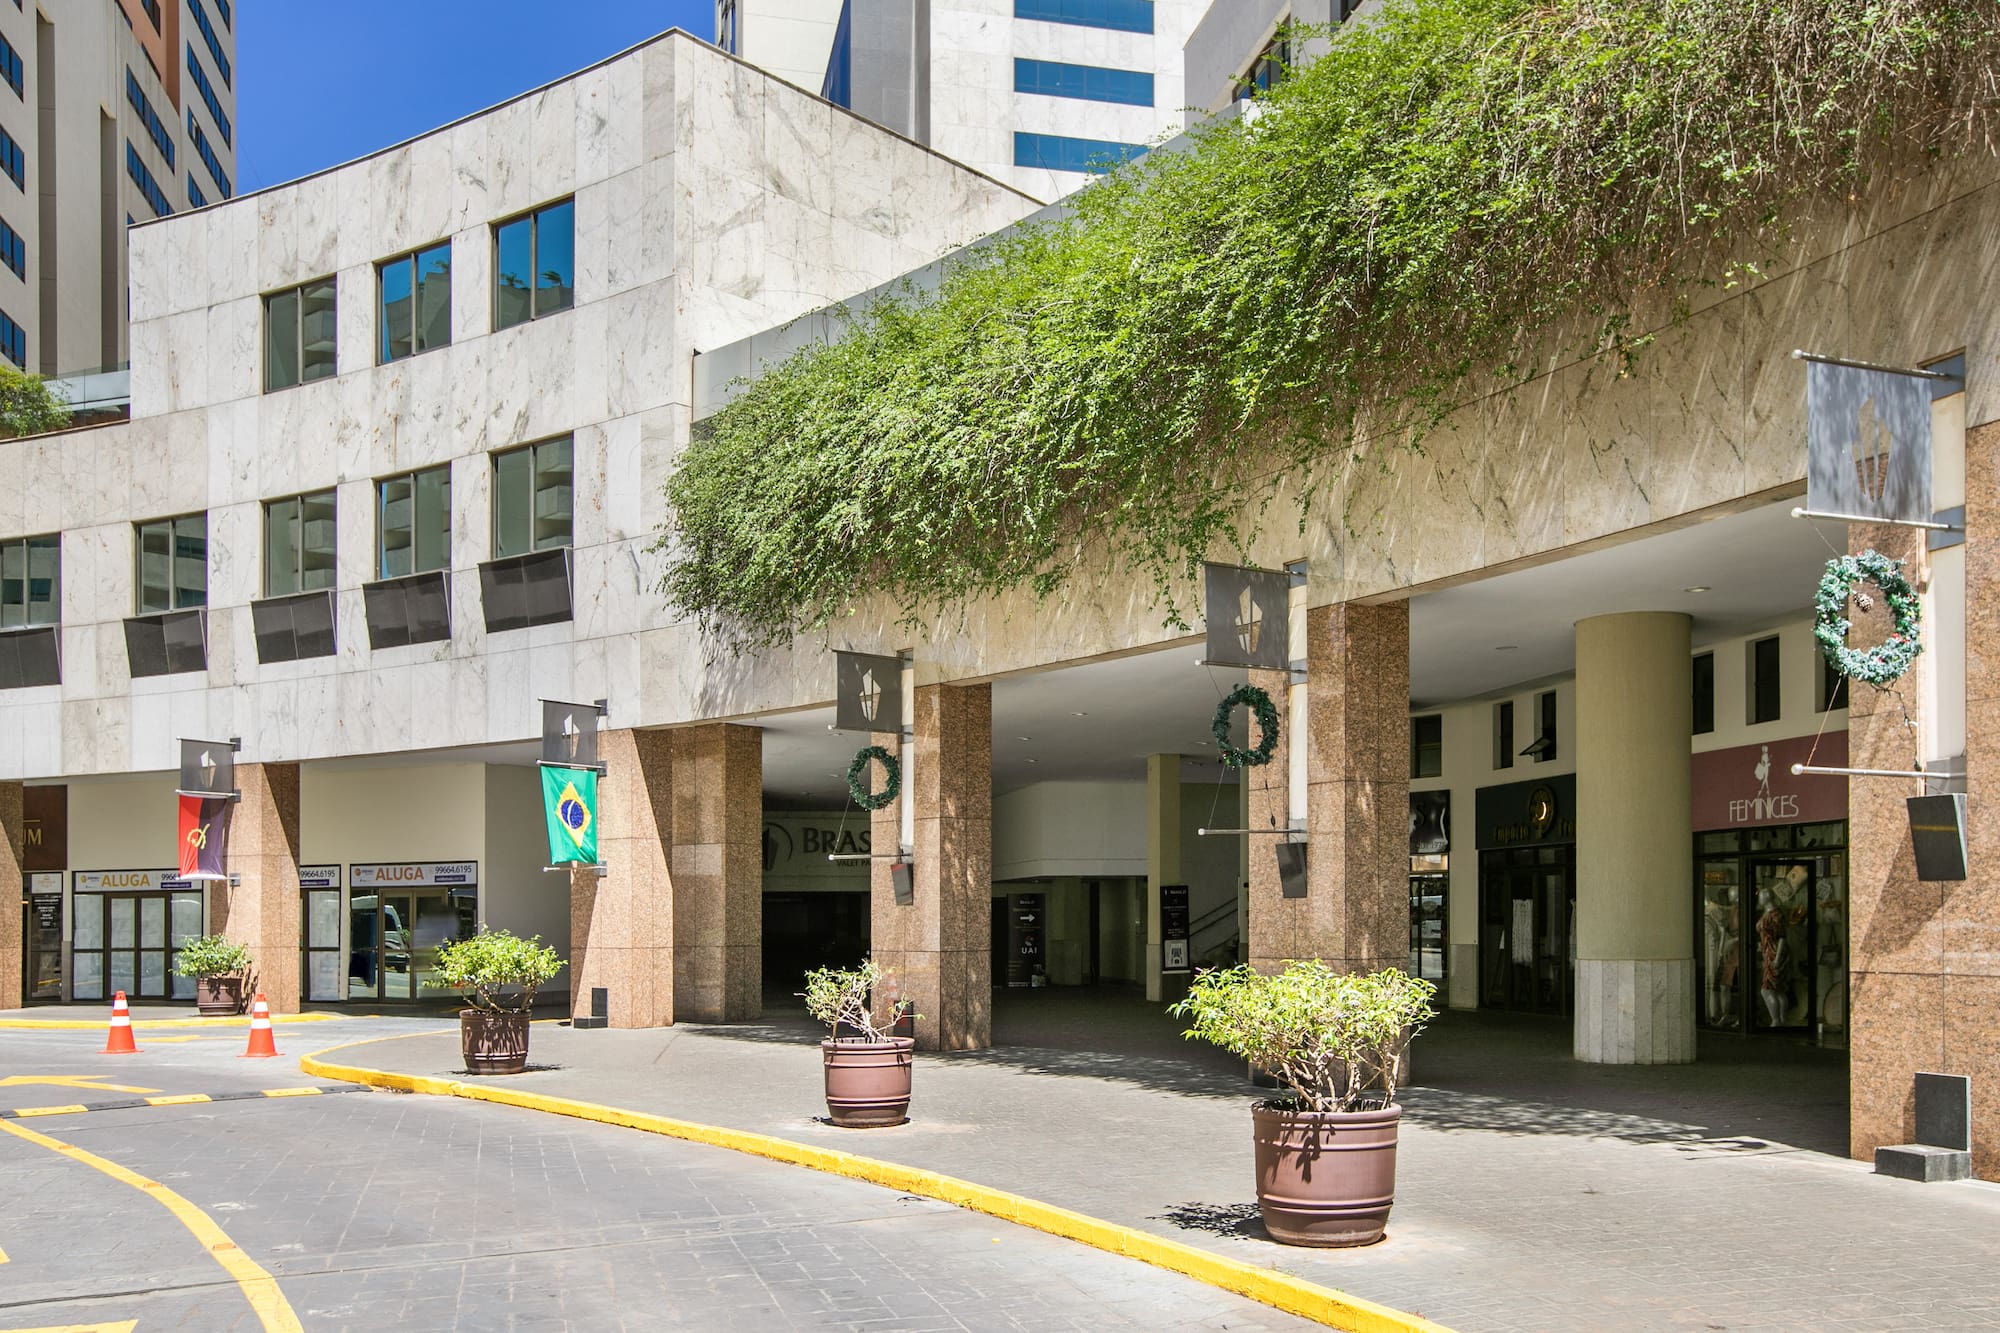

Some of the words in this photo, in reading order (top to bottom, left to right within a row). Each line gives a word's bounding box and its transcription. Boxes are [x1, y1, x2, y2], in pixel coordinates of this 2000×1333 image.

[300, 869, 336, 878] 99664.6195
[376, 866, 424, 881] ALUGA
[435, 864, 472, 874] 99664.6195
[101, 873, 151, 888] ALUGA
[1021, 946, 1038, 955] UAI
